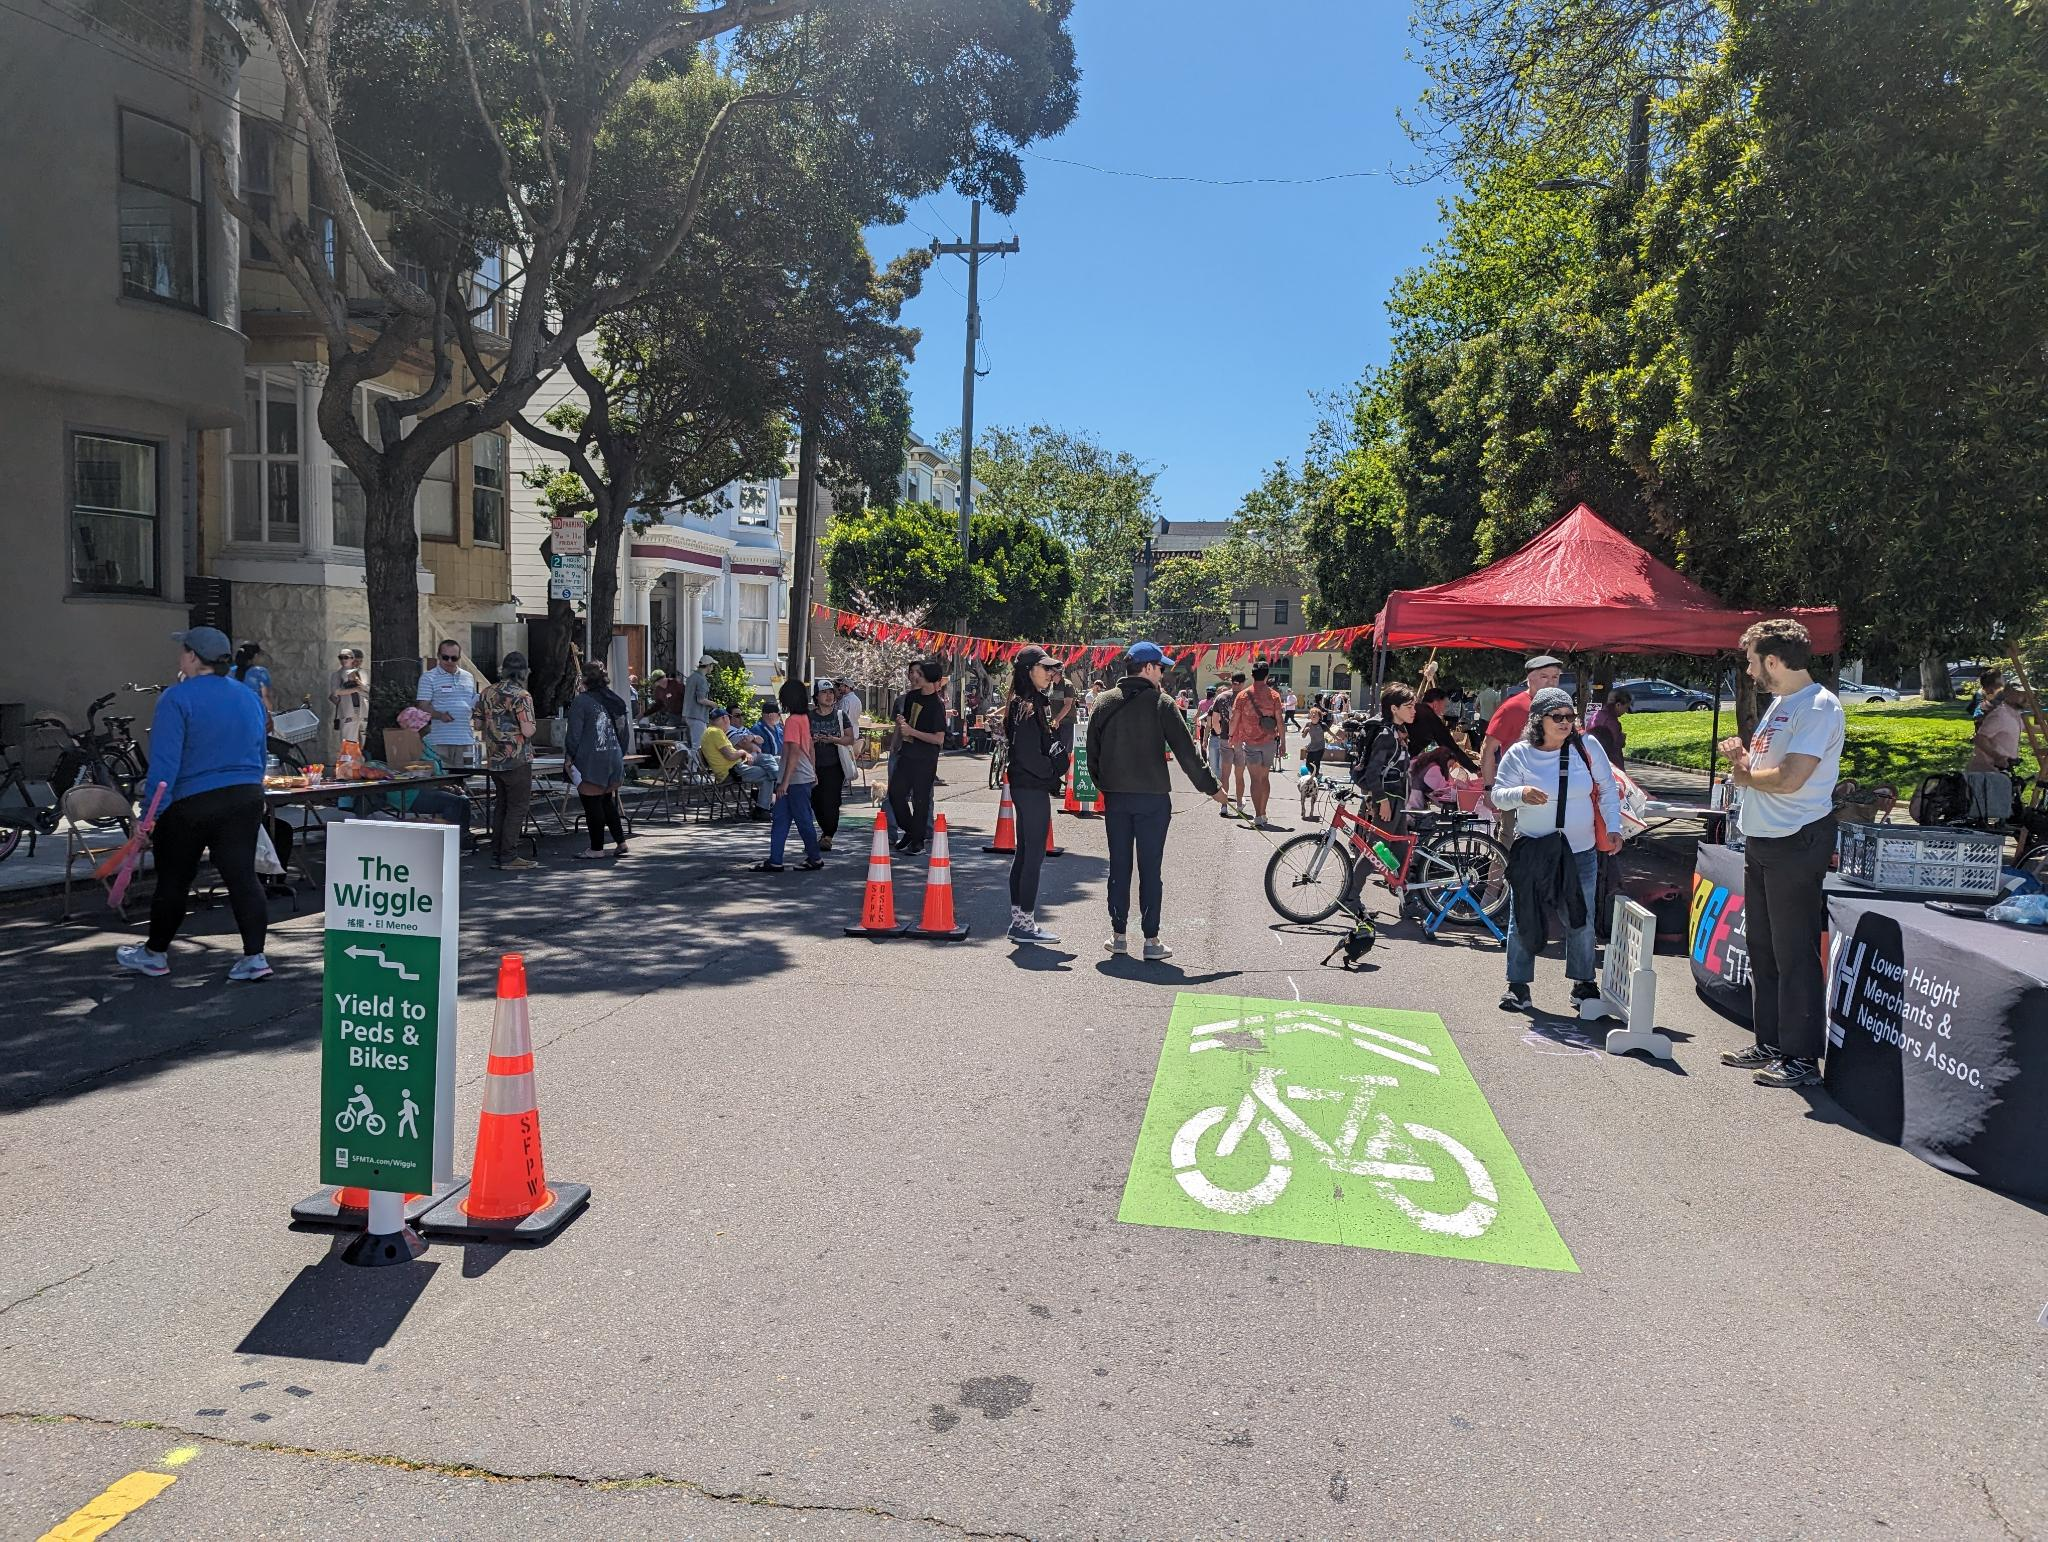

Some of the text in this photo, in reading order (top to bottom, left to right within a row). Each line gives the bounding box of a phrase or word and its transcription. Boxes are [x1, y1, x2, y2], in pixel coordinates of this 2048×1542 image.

[563, 520, 583, 528] PARKING
[358, 856, 409, 883] The
[333, 883, 432, 917] Wiggle
[375, 919, 418, 931] El Meneo
[1870, 949, 1961, 1009] Lower Haight
[335, 993, 426, 1020] Yield to
[1863, 976, 1952, 1040] Merchants &
[340, 1020, 420, 1046] Peds &
[349, 1046, 409, 1071] Bikes
[1857, 1004, 1985, 1090] Neighbors Assoc.
[352, 1155, 417, 1169] SFMTA.com/Wiggle
